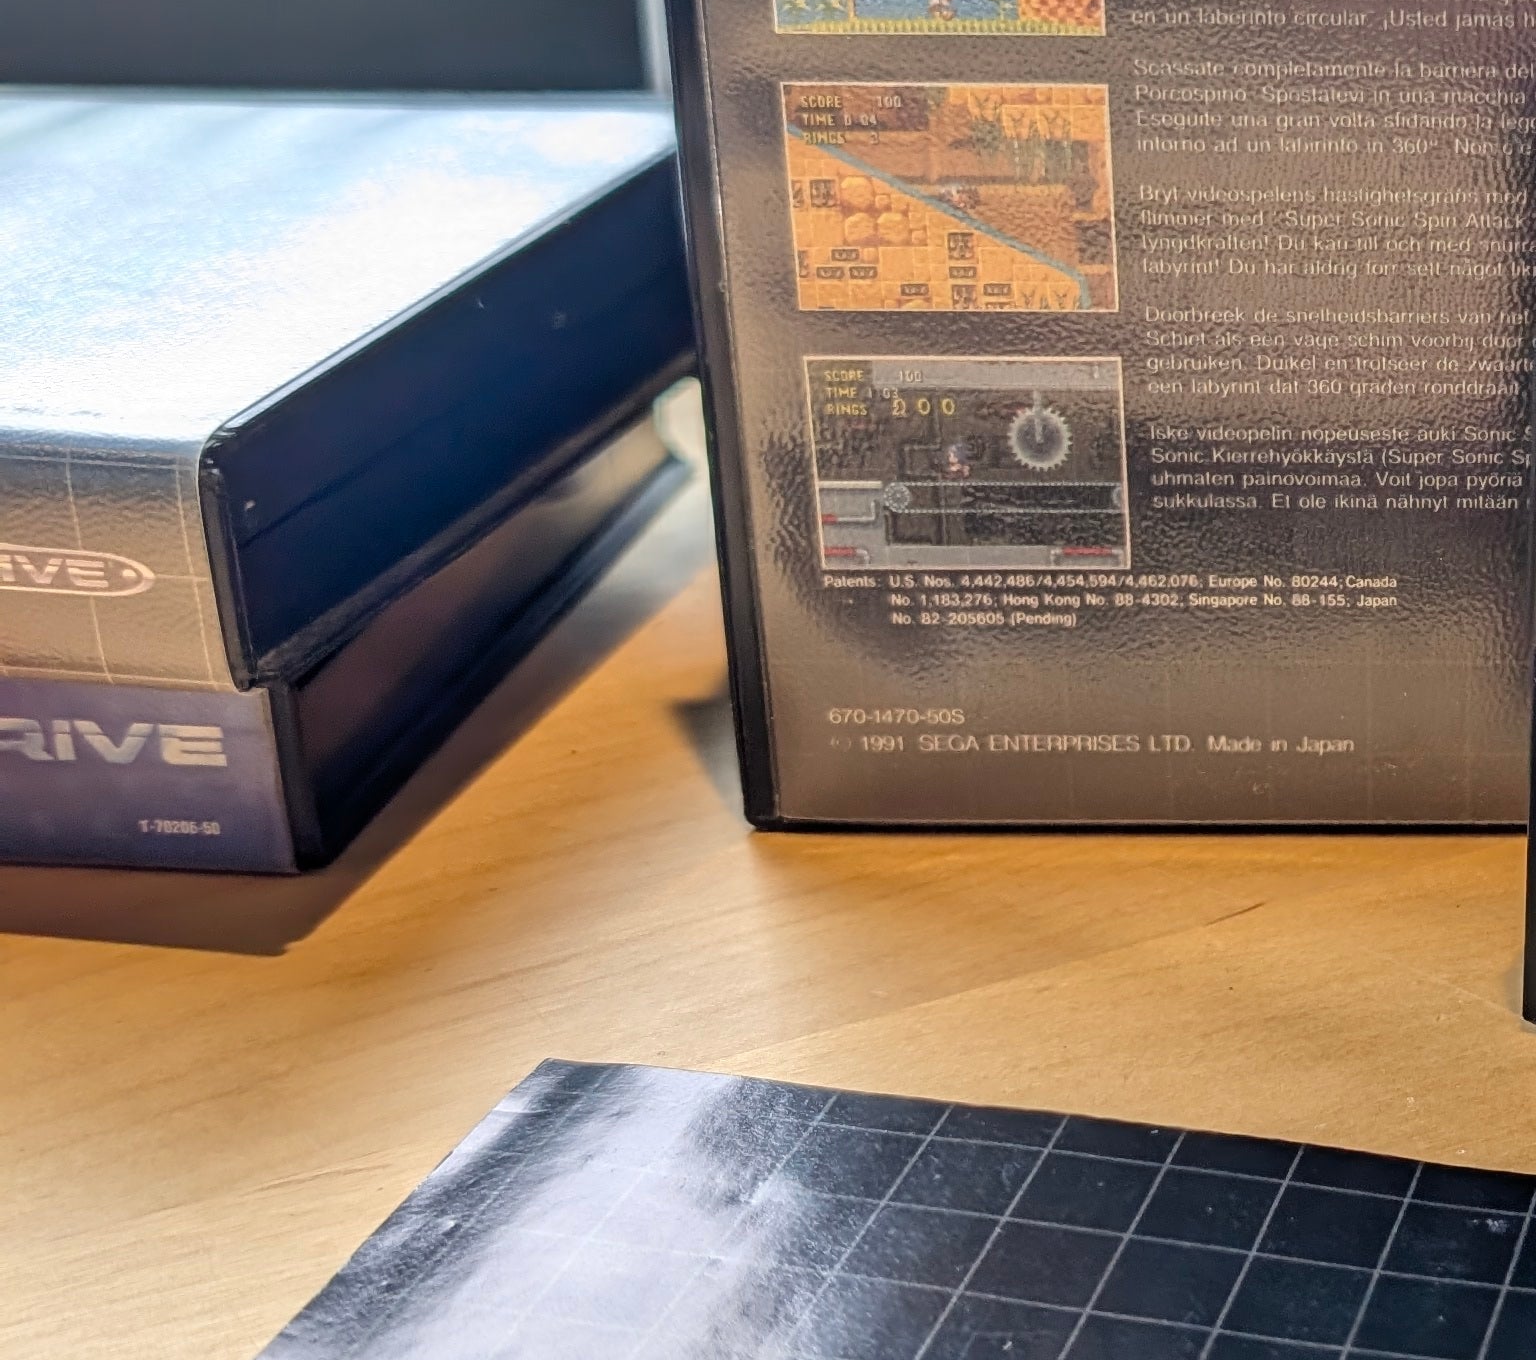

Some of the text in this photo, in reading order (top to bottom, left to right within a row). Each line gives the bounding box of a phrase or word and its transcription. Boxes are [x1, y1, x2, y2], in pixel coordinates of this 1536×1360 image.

[800, 95, 902, 109] SCORE 100
[803, 113, 836, 127] TIME
[823, 370, 864, 382] SCORE
[825, 387, 857, 399] TIME
[824, 403, 868, 416] RINGS
[824, 575, 881, 588] Patents:
[889, 575, 918, 588] U.S.
[924, 575, 954, 588] Nos.
[1208, 574, 1258, 589] Europe
[1263, 574, 1286, 588] No.
[1346, 574, 1398, 588] Canada
[891, 594, 914, 607] No.
[1003, 594, 1039, 609] Hong
[1044, 594, 1081, 609] Kong
[1085, 594, 1109, 607] No.
[1189, 593, 1258, 608] Singapore
[1263, 594, 1286, 607] No.
[1357, 594, 1398, 608] Japan
[892, 612, 914, 625] No.
[1011, 611, 1077, 627] (Pending)
[829, 708, 966, 726] 670-1470-50S
[861, 736, 904, 752] 1991
[918, 735, 980, 753] SEGA
[989, 735, 1140, 753] ENTERPRISES
[1149, 735, 1195, 753] LTD.
[1207, 735, 1262, 753] Made
[1271, 739, 1287, 752] in
[1296, 736, 1355, 757] Japan
